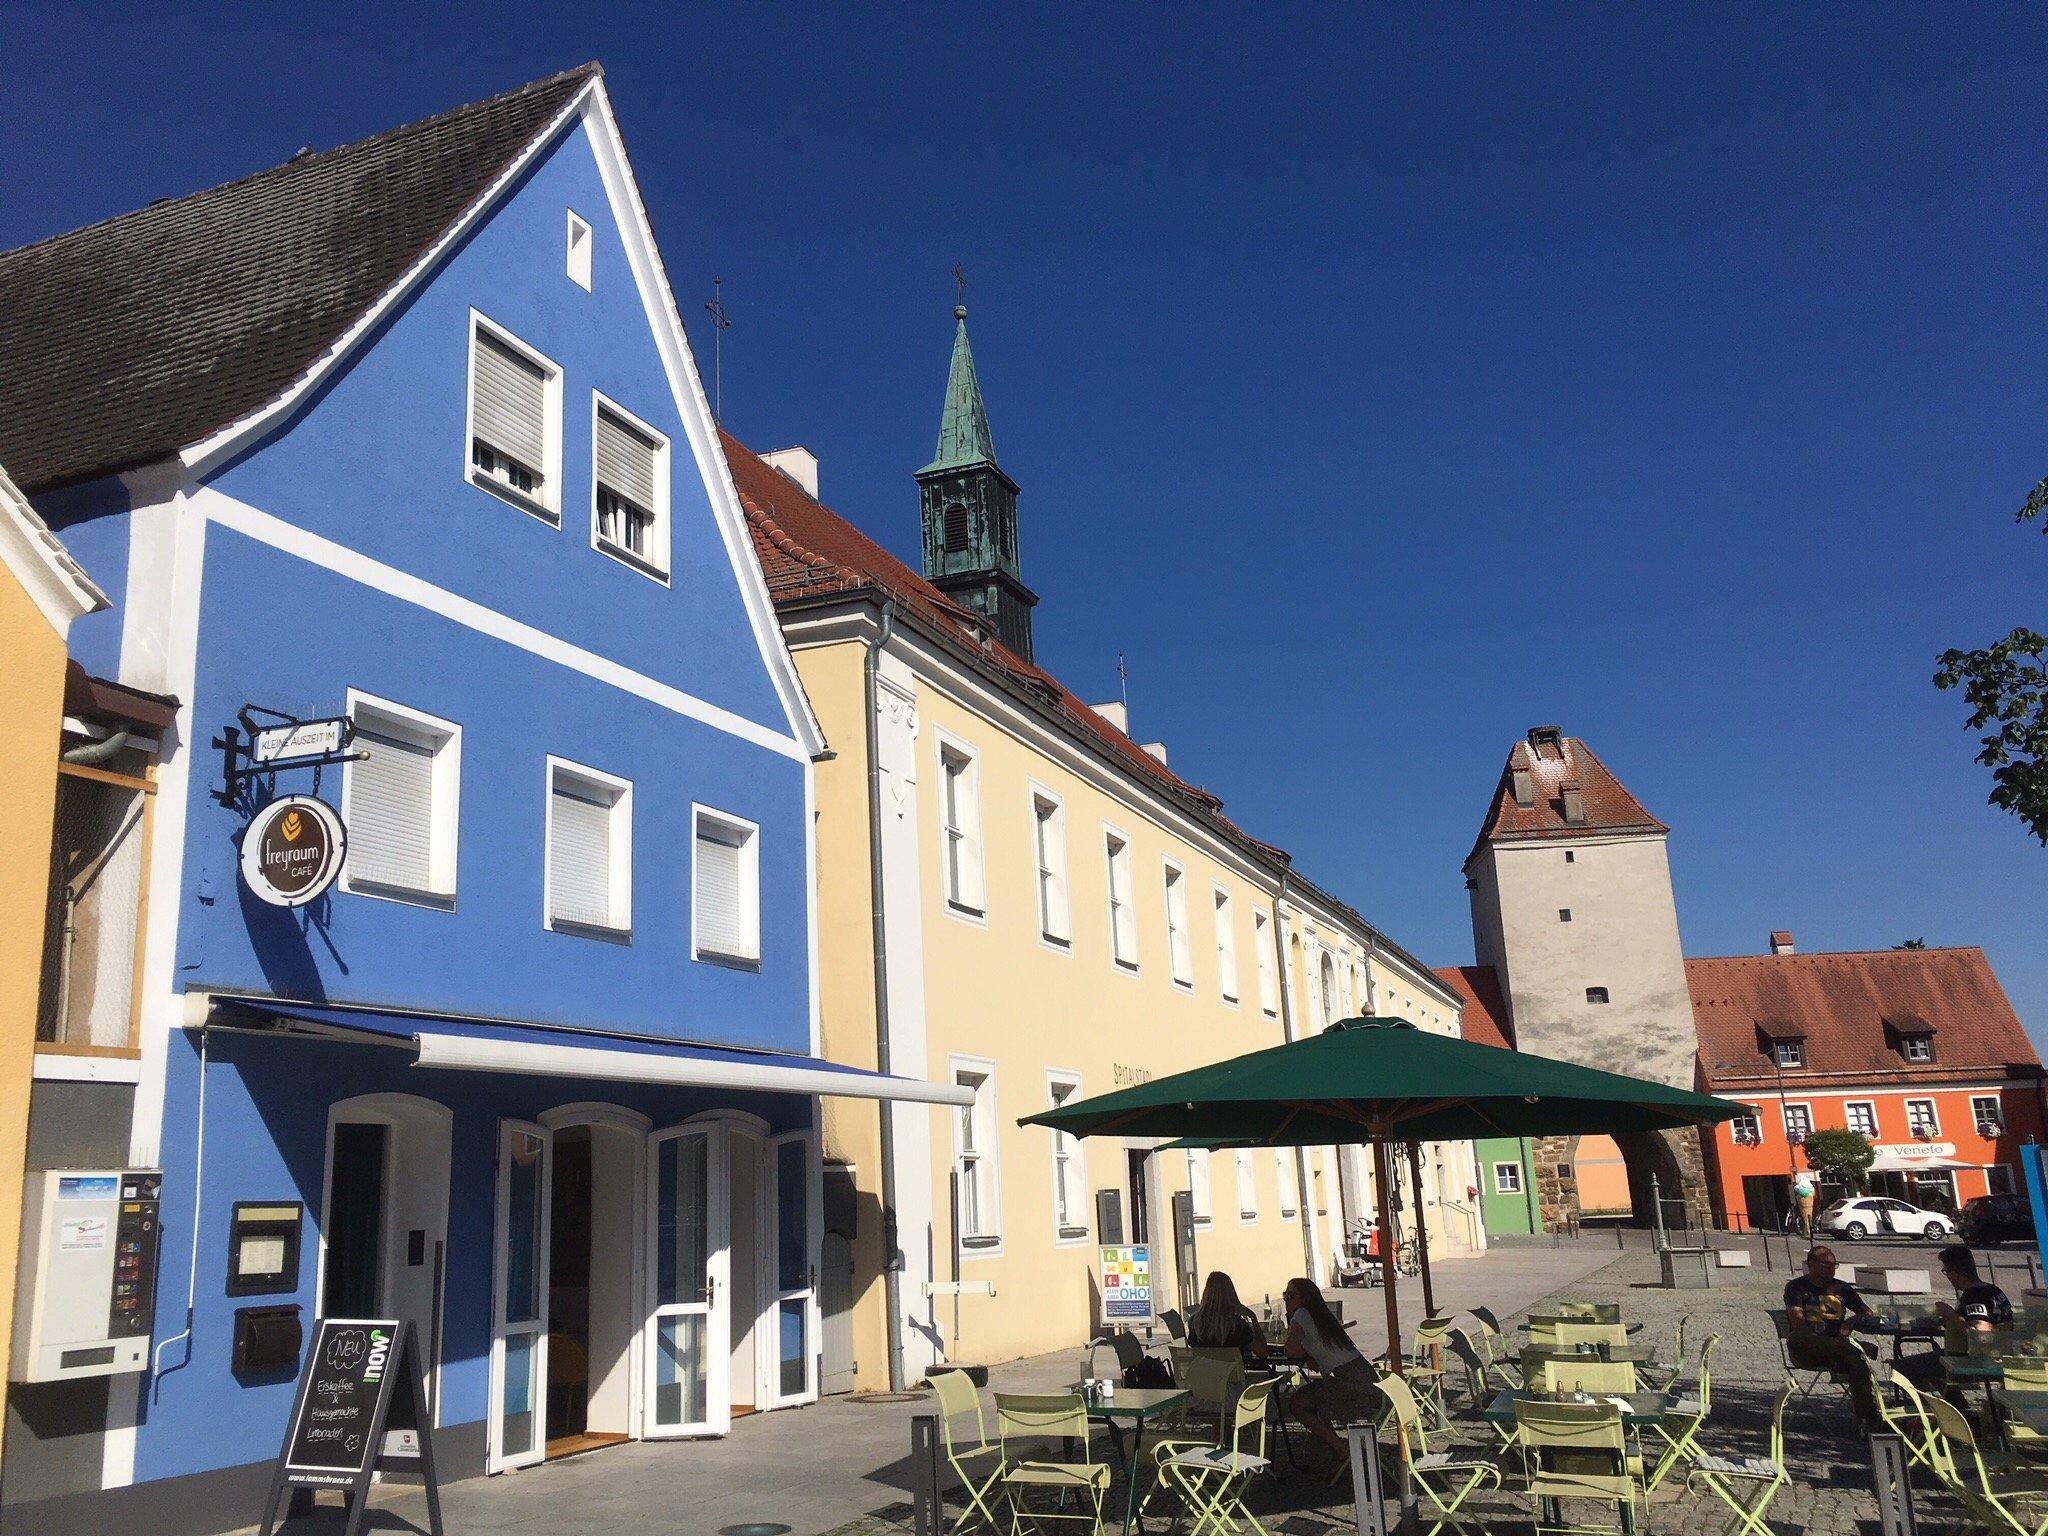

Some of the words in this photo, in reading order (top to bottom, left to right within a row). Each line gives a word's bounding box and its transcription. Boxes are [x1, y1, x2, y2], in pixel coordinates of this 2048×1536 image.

[261, 737, 290, 750] KLEINE
[291, 732, 324, 746] AUSZEIT
[325, 731, 335, 741] IM
[265, 838, 319, 871] freyraum
[291, 863, 313, 877] CAFÉ
[1894, 1145, 1944, 1156] Veneto
[335, 1339, 360, 1357] NEU
[363, 1329, 390, 1378] now
[317, 1378, 354, 1392] Eiskaffee
[331, 1392, 339, 1404] &
[311, 1406, 360, 1421] Hausgemachte
[307, 1427, 343, 1439] Limonaden
